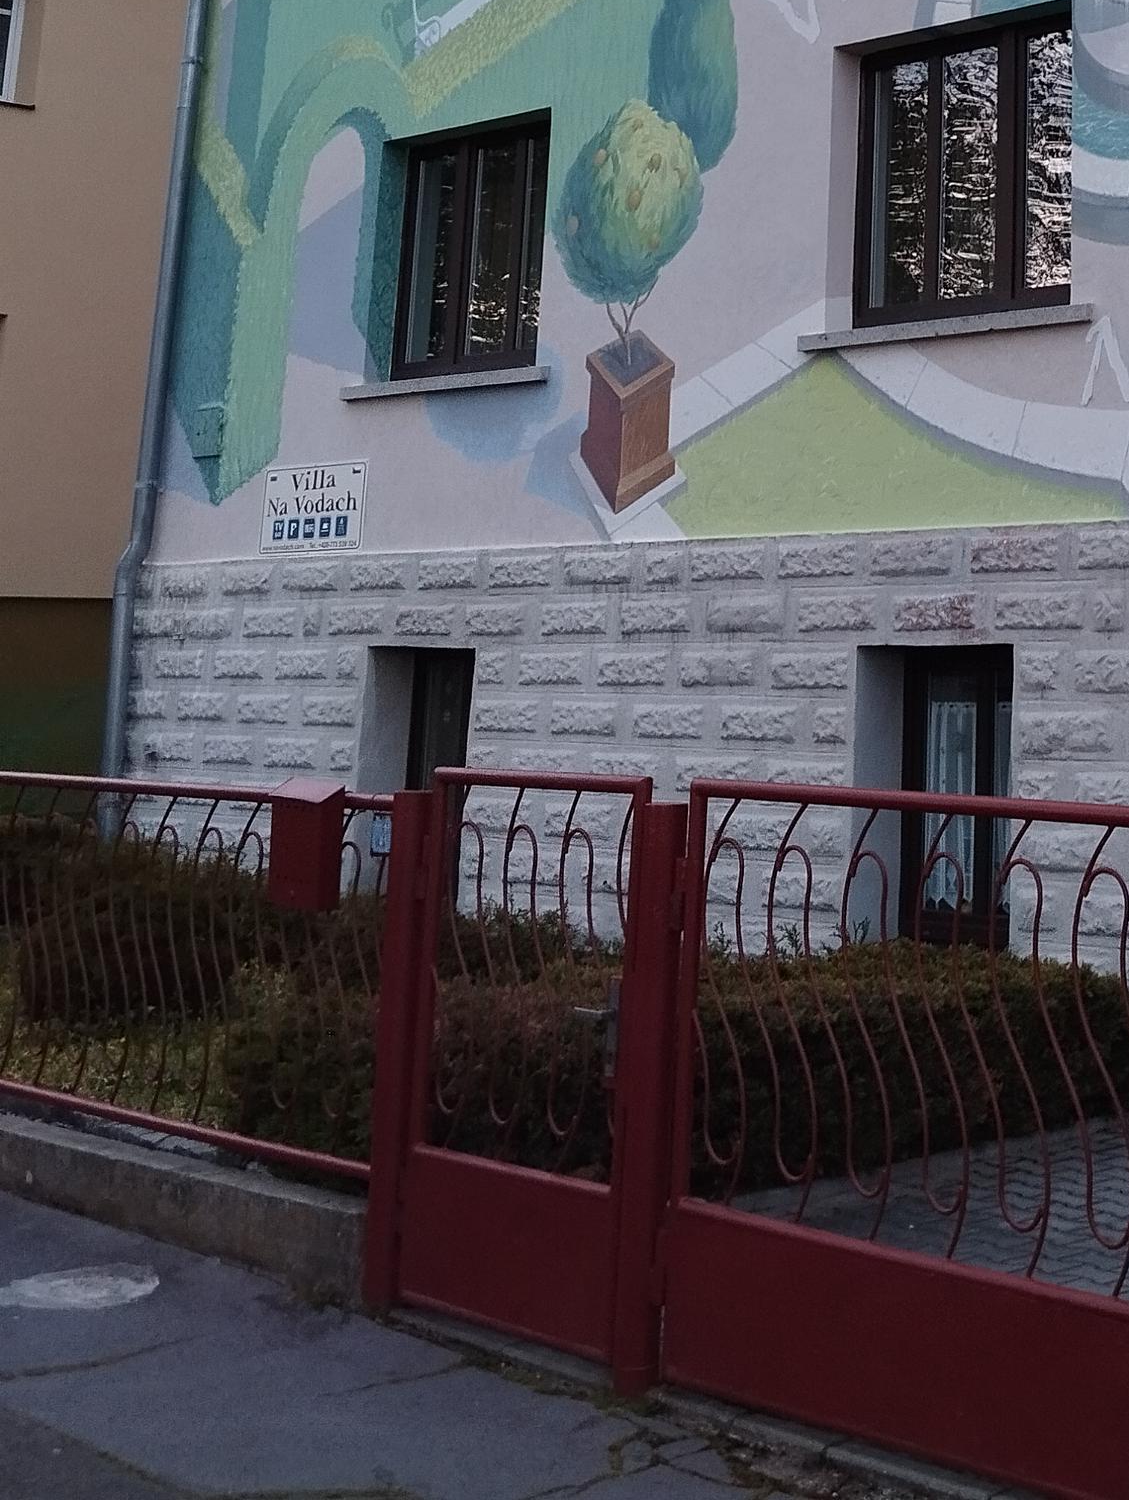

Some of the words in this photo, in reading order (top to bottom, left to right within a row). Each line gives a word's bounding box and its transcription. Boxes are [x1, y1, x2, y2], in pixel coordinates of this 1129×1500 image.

[292, 469, 336, 492] Villa
[266, 497, 288, 518] Na
[294, 490, 358, 515] Vodach
[290, 522, 297, 536] P
